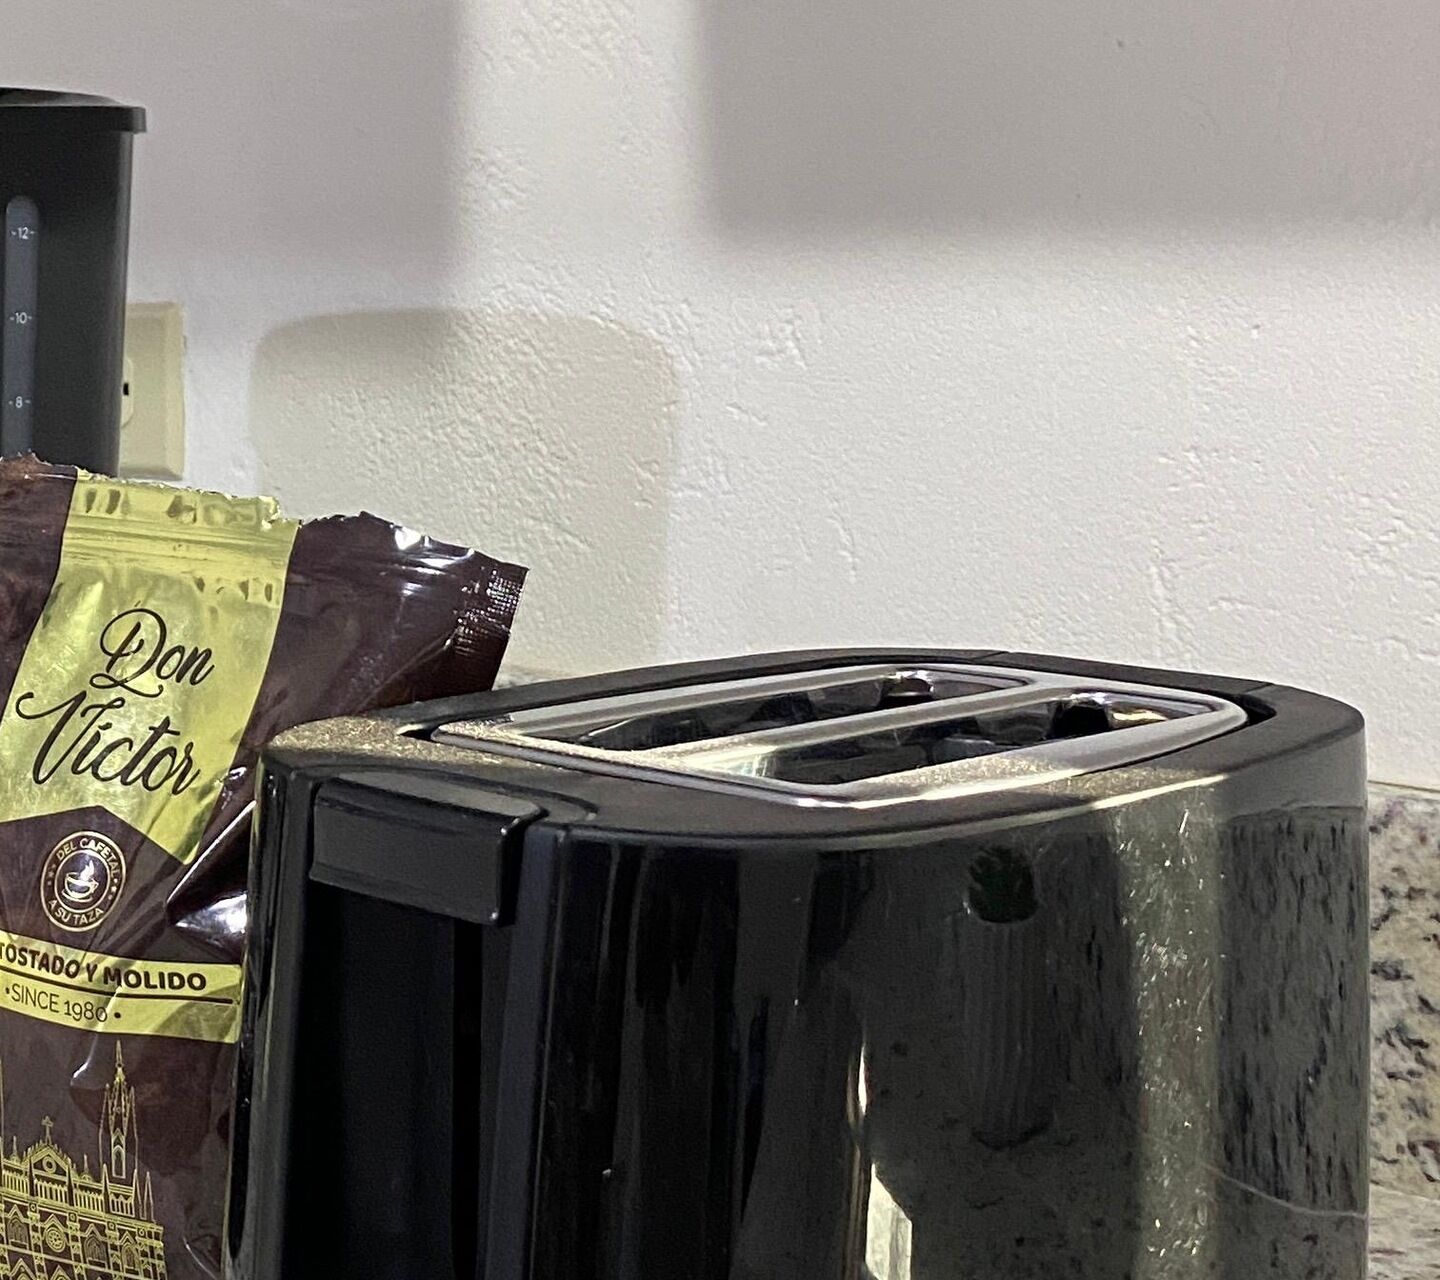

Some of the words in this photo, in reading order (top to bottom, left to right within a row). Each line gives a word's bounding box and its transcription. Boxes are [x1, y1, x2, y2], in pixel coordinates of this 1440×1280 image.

[17, 226, 29, 240] 12
[15, 312, 28, 324] 10
[89, 608, 215, 698] Don
[56, 841, 77, 861] DEL
[79, 837, 120, 878] CAFETAL
[48, 900, 58, 910] A
[54, 907, 72, 923] SU
[72, 907, 105, 926] TAZA
[86, 964, 98, 982] Y
[103, 970, 207, 991] MOLIDO
